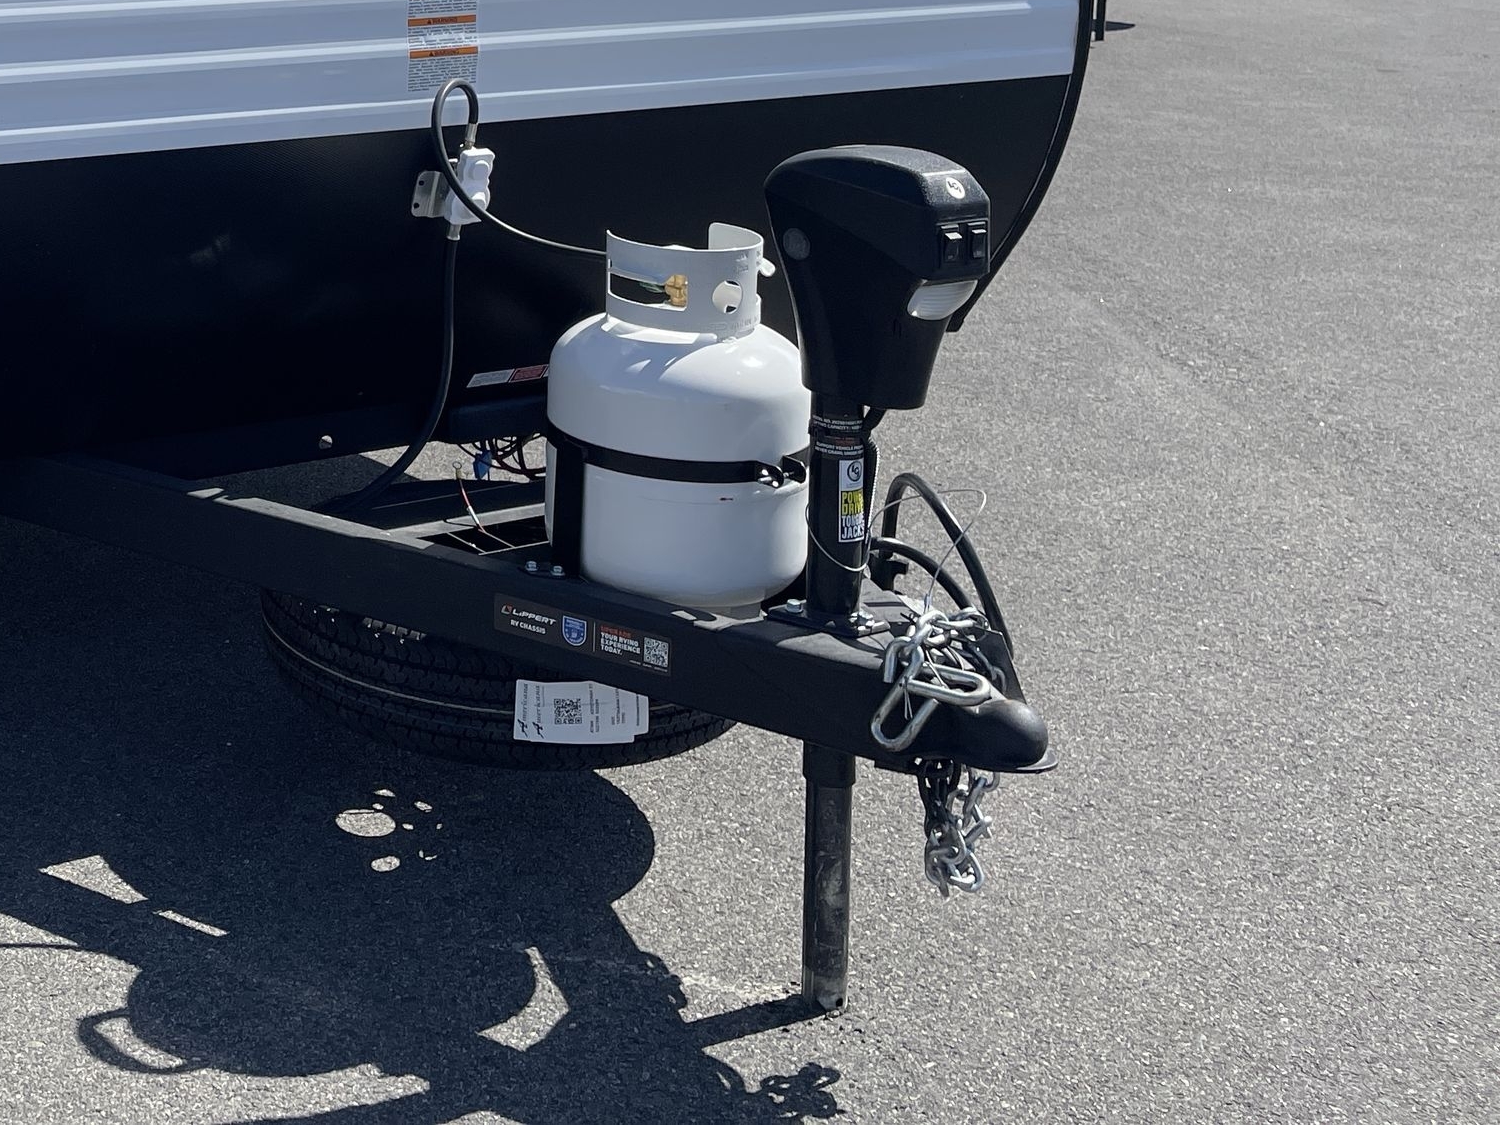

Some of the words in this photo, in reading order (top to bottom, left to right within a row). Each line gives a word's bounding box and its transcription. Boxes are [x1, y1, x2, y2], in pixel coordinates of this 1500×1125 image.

[510, 619, 520, 627] RV
[519, 622, 546, 634] CHASSIS
[600, 632, 618, 642] YOUR
[600, 638, 641, 654] EXPERIENCE
